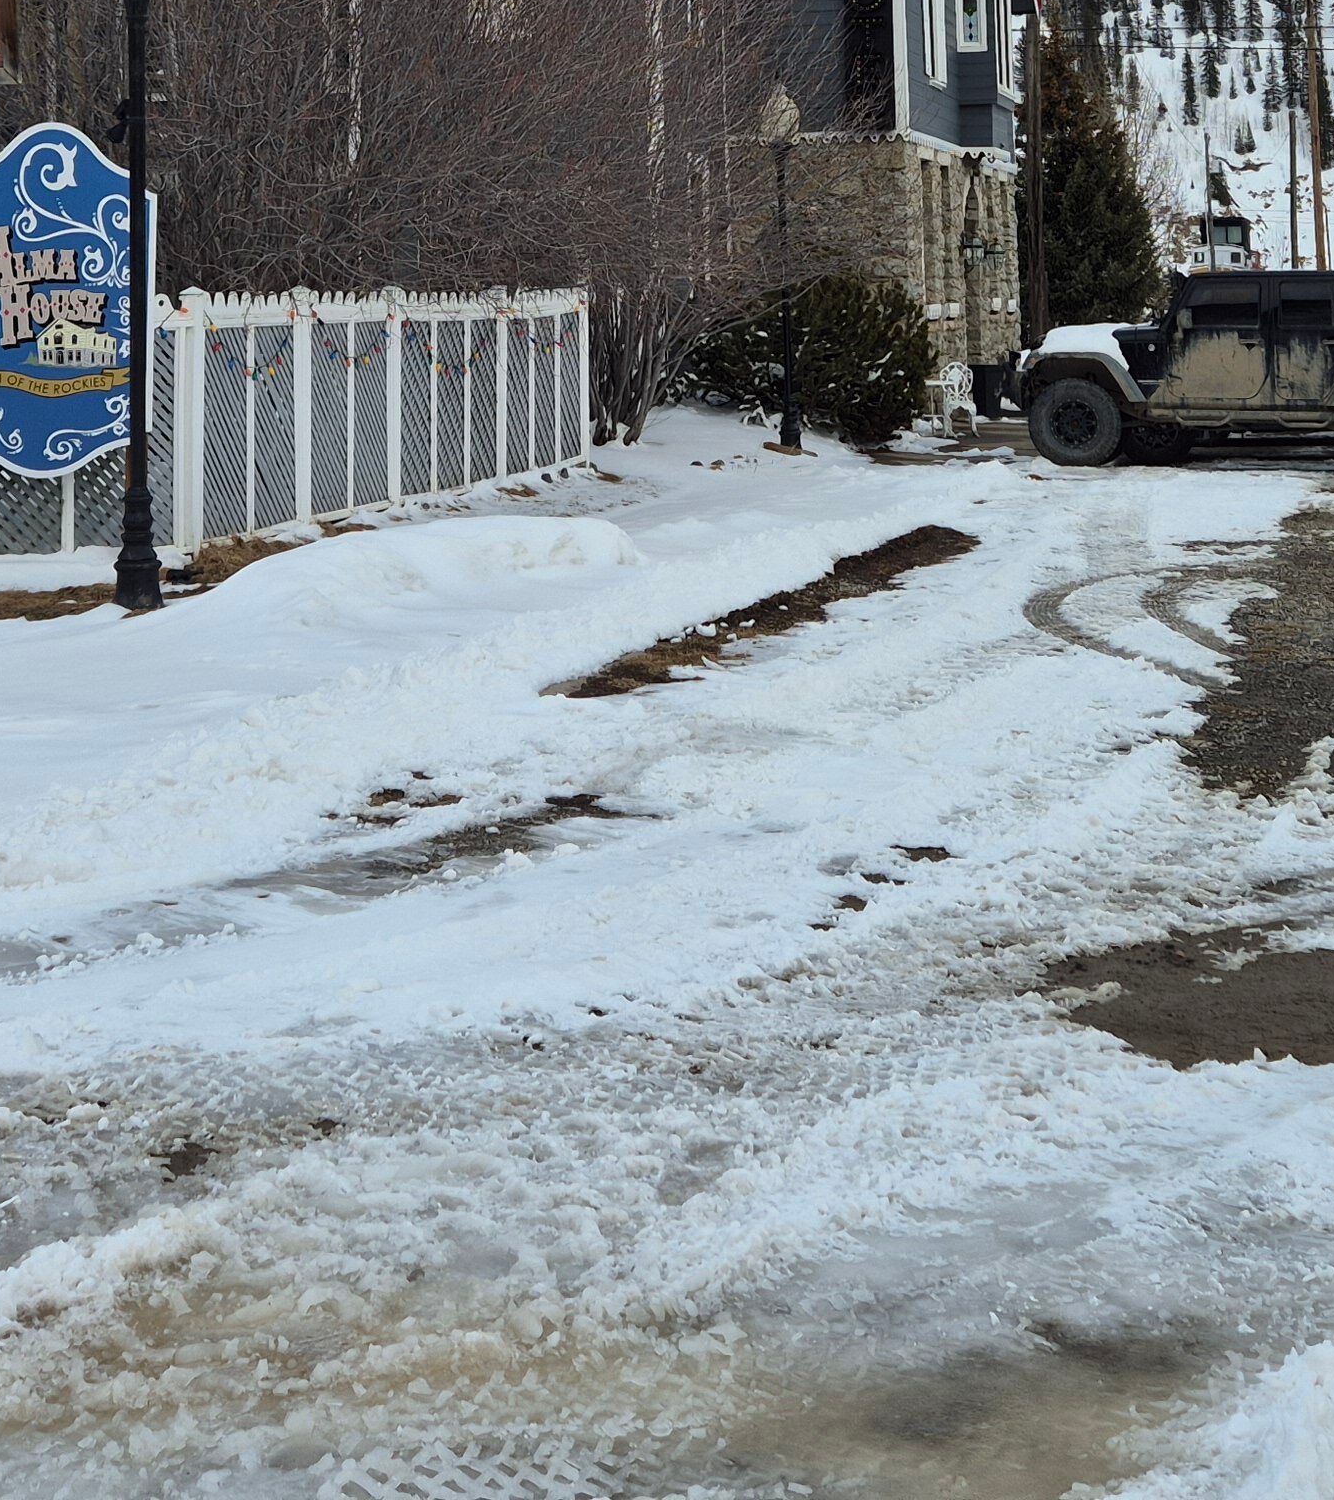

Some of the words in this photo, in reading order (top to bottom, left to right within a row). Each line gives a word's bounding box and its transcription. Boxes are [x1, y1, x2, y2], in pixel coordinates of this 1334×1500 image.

[0, 284, 107, 346] HOUSE
[7, 375, 24, 387] OF
[28, 380, 49, 394] THE
[53, 377, 106, 394] ROCKIES
